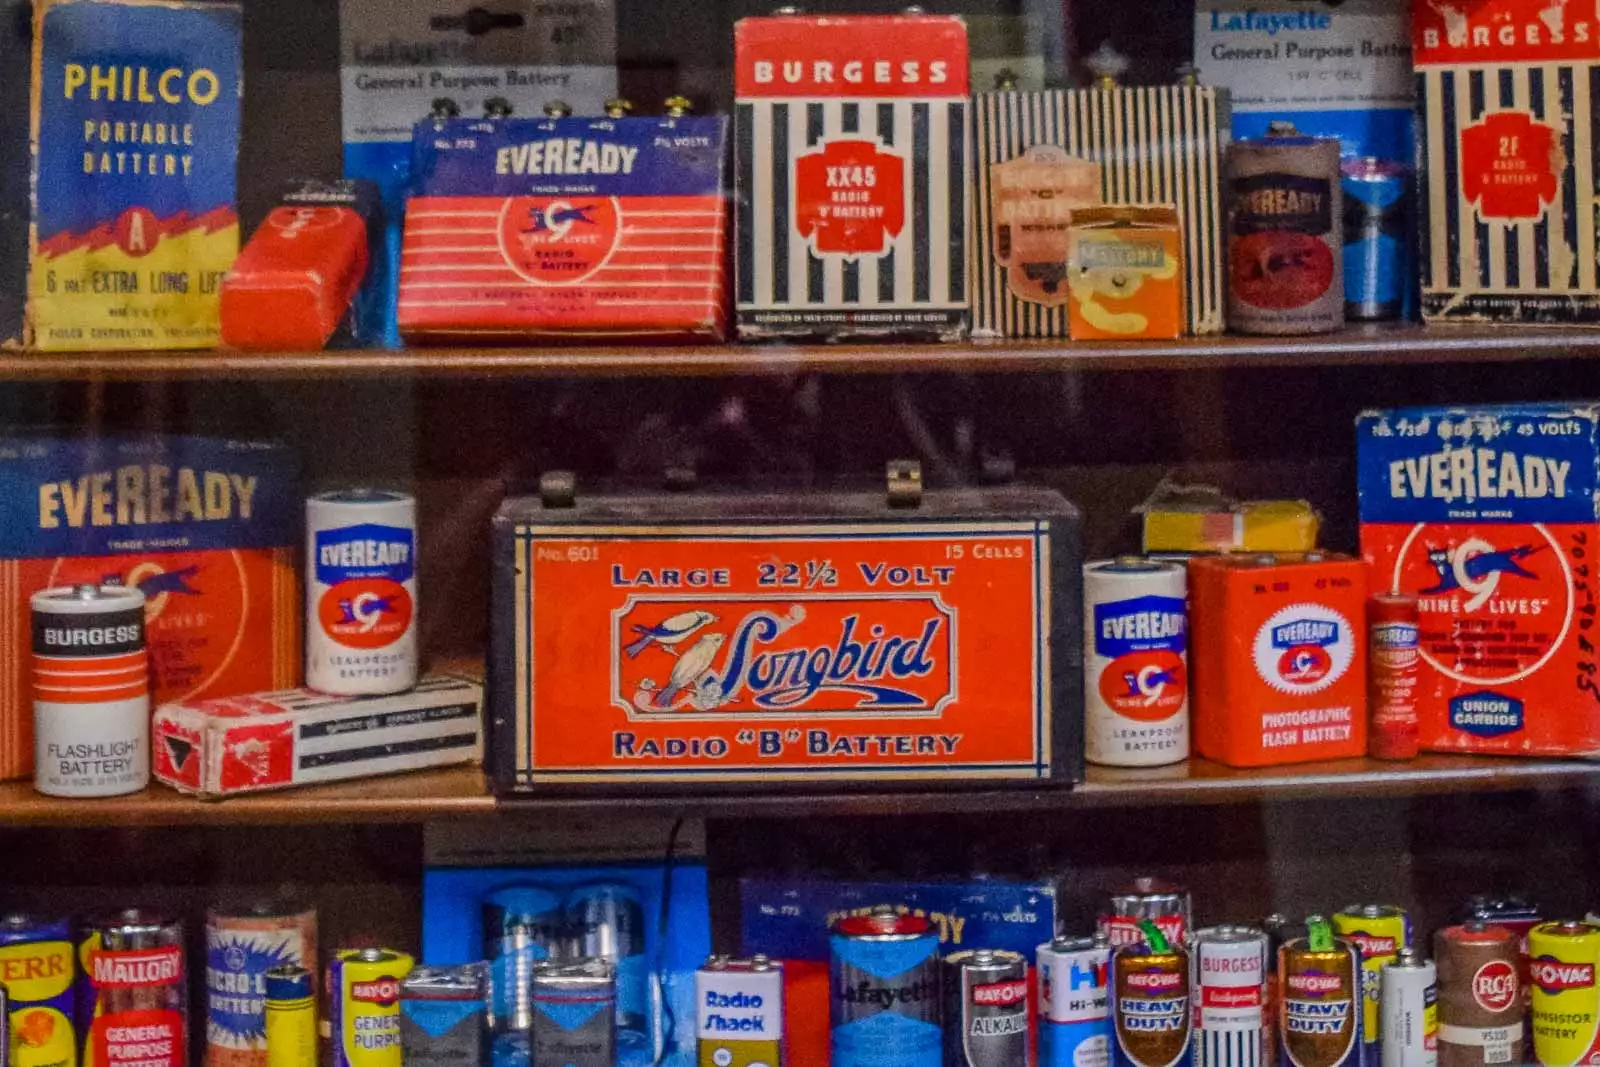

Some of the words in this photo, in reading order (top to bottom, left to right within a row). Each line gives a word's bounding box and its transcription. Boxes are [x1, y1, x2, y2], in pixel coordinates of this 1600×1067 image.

[1212, 43, 1279, 60] General
[1286, 42, 1354, 60] Purpose
[753, 61, 948, 83] BURGESS
[64, 64, 220, 105] PHILCO
[84, 120, 194, 145] PORTABLE
[83, 151, 193, 176] BATTERY
[495, 138, 639, 175] EVEREADY
[826, 166, 876, 188] XX45
[130, 211, 147, 250] A
[46, 271, 57, 294] 6
[92, 270, 138, 294] EXTRA
[151, 271, 188, 294] LONG
[1539, 420, 1582, 436] VOLTS
[1389, 448, 1571, 499] EVEREADY
[38, 463, 257, 529] EVEREADY
[320, 540, 410, 567] EVEREADY
[567, 546, 598, 561] 601
[945, 545, 964, 559] 15
[973, 543, 1024, 558] CELLS
[612, 564, 730, 588] LARGE
[856, 562, 956, 587] VOLT
[44, 625, 139, 646] BURGESS
[1277, 621, 1335, 643] EVEREADY
[703, 611, 942, 709] Songbird
[1262, 706, 1352, 729] PHOTOGRAPHIC
[1462, 700, 1510, 713] UNION
[1454, 711, 1518, 726] CARBIDE
[612, 731, 728, 759] RADIO
[806, 729, 963, 756] BATTERY
[1262, 733, 1297, 748] FLASH
[1303, 725, 1351, 743] BATTERY
[47, 738, 139, 760] FLASHLIGHT
[60, 757, 132, 775] BATTERY
[94, 951, 181, 983] MALLORY
[1203, 956, 1261, 972] BURGESS
[706, 990, 763, 1008] Radio
[1122, 999, 1185, 1013] HEAVY
[1287, 1001, 1349, 1017] HEAVY
[354, 1015, 399, 1031] GENER
[705, 1013, 764, 1032] Shack
[1127, 1014, 1180, 1029] DUTY
[1288, 1018, 1345, 1033] DUTY
[106, 1024, 173, 1042] GENERAL
[107, 1040, 173, 1058] PURPOSE
